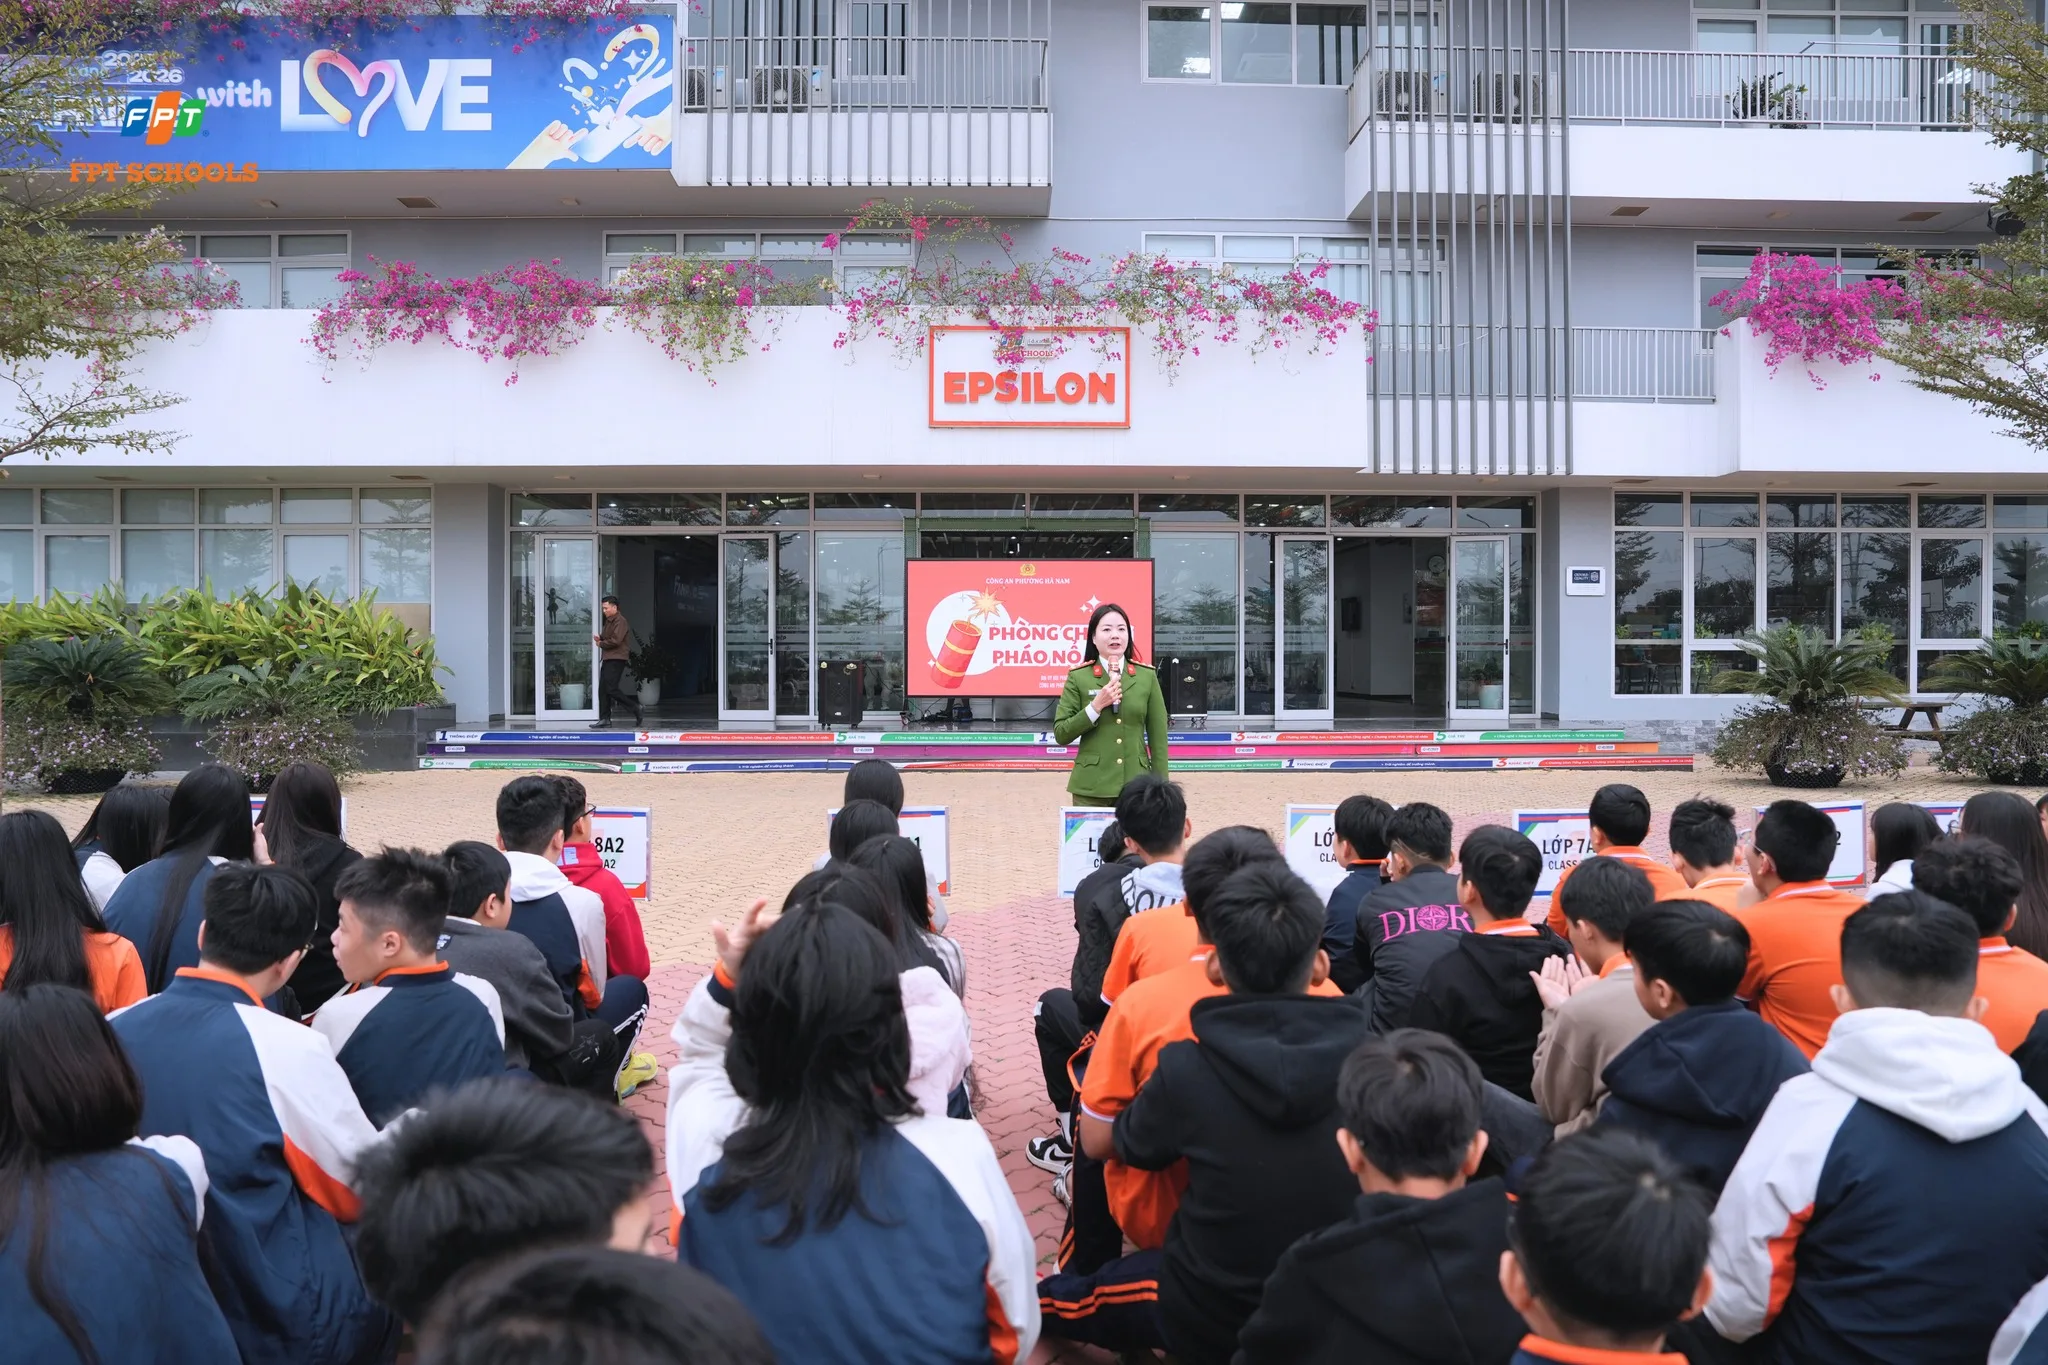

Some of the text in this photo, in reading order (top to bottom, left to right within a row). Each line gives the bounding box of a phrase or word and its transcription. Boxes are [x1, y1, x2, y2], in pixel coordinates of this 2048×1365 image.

[129, 69, 183, 84] 2026
[196, 79, 272, 108] with
[280, 48, 493, 138] LOVE
[943, 370, 1116, 404] EPSILON
[1045, 577, 1054, 585] HÀ
[989, 620, 1088, 641] PHÒNG CH
[993, 641, 1081, 665] PHÁO NỔ
[439, 731, 448, 740] 1
[638, 731, 650, 741] 3
[836, 732, 847, 742] 5
[1039, 732, 1048, 742] 1
[1235, 732, 1245, 742] 3
[1436, 731, 1446, 741] 5
[423, 758, 434, 768] 5
[642, 762, 651, 771] 1
[1285, 758, 1295, 768] 1
[1496, 758, 1508, 767] 3
[1314, 828, 1335, 848] LỚ
[595, 836, 624, 853] 8A2
[1543, 835, 1596, 854] LỚP 7A
[604, 858, 616, 868] A2
[1320, 853, 1336, 863] CLA
[1548, 859, 1578, 870] CLASS
[1378, 904, 1474, 943] DIOR
